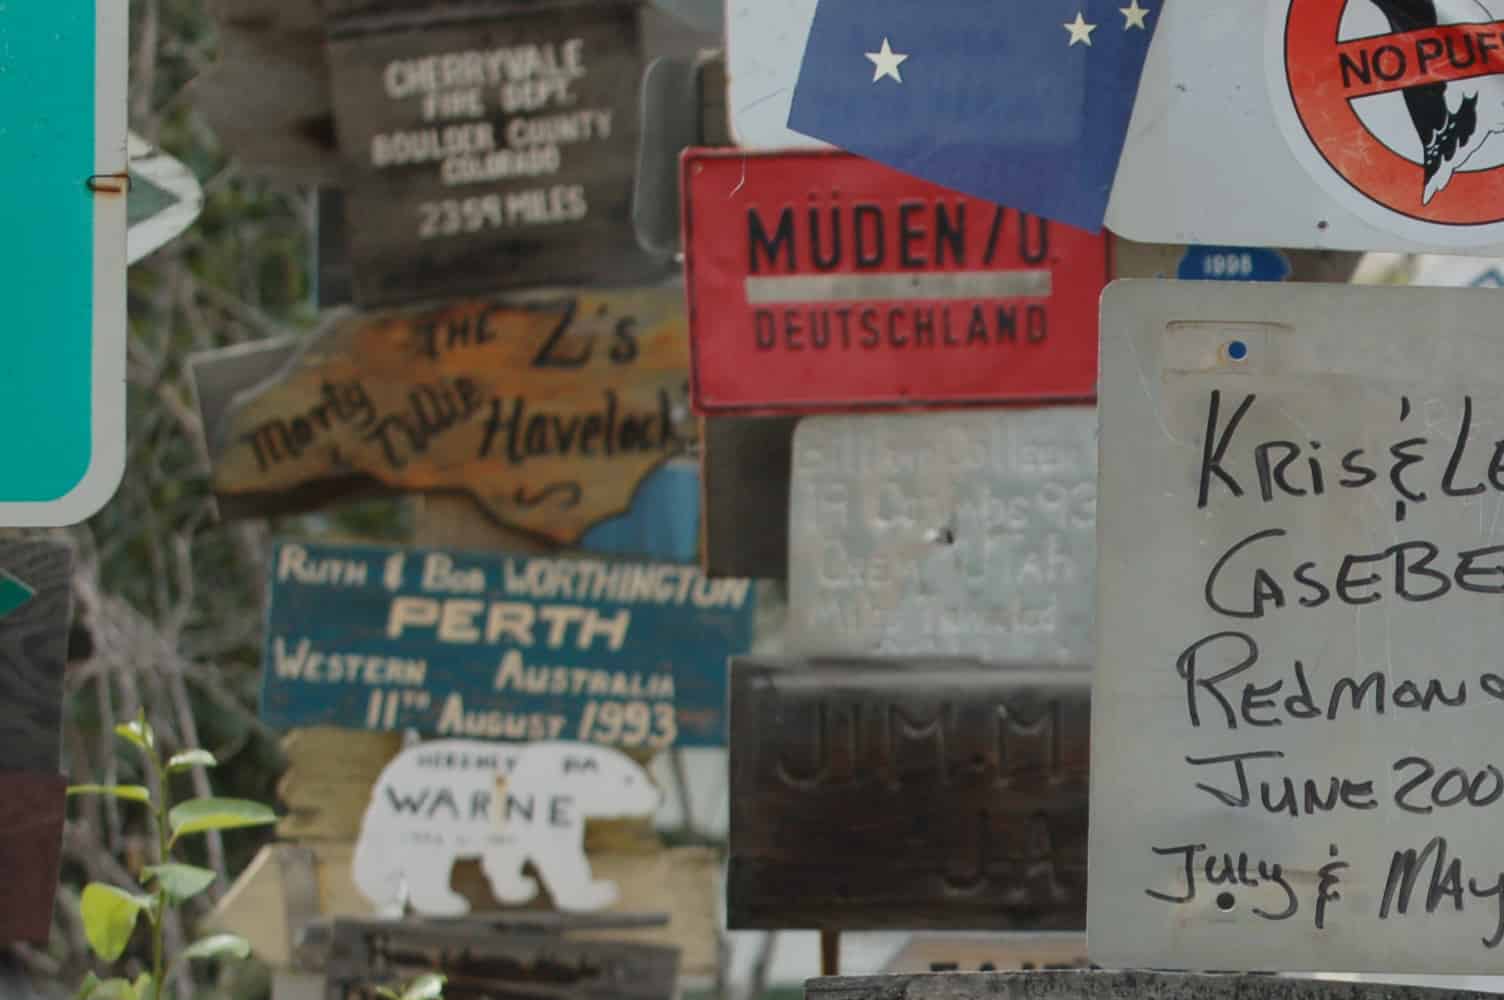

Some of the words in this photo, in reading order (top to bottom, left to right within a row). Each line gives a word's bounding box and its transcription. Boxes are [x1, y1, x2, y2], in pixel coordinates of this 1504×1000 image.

[383, 39, 586, 98] CHERRYVALE
[1338, 46, 1407, 88] NO
[371, 122, 495, 166] BOULDER
[506, 109, 613, 147] COUNTY
[442, 146, 560, 185] COLORADO
[506, 185, 588, 224] MILES
[416, 312, 498, 360] THE
[754, 305, 1048, 351] DEUTSCHLAND
[503, 557, 750, 608] WORTHINGTON
[386, 597, 631, 651] PERTH
[273, 636, 427, 686] WESTERN
[495, 649, 675, 699] AUSTRALIA
[438, 692, 567, 740] AUGUST
[578, 701, 677, 748] 1993
[385, 784, 575, 828] WARNE
[1186, 751, 1379, 816] JUNE
